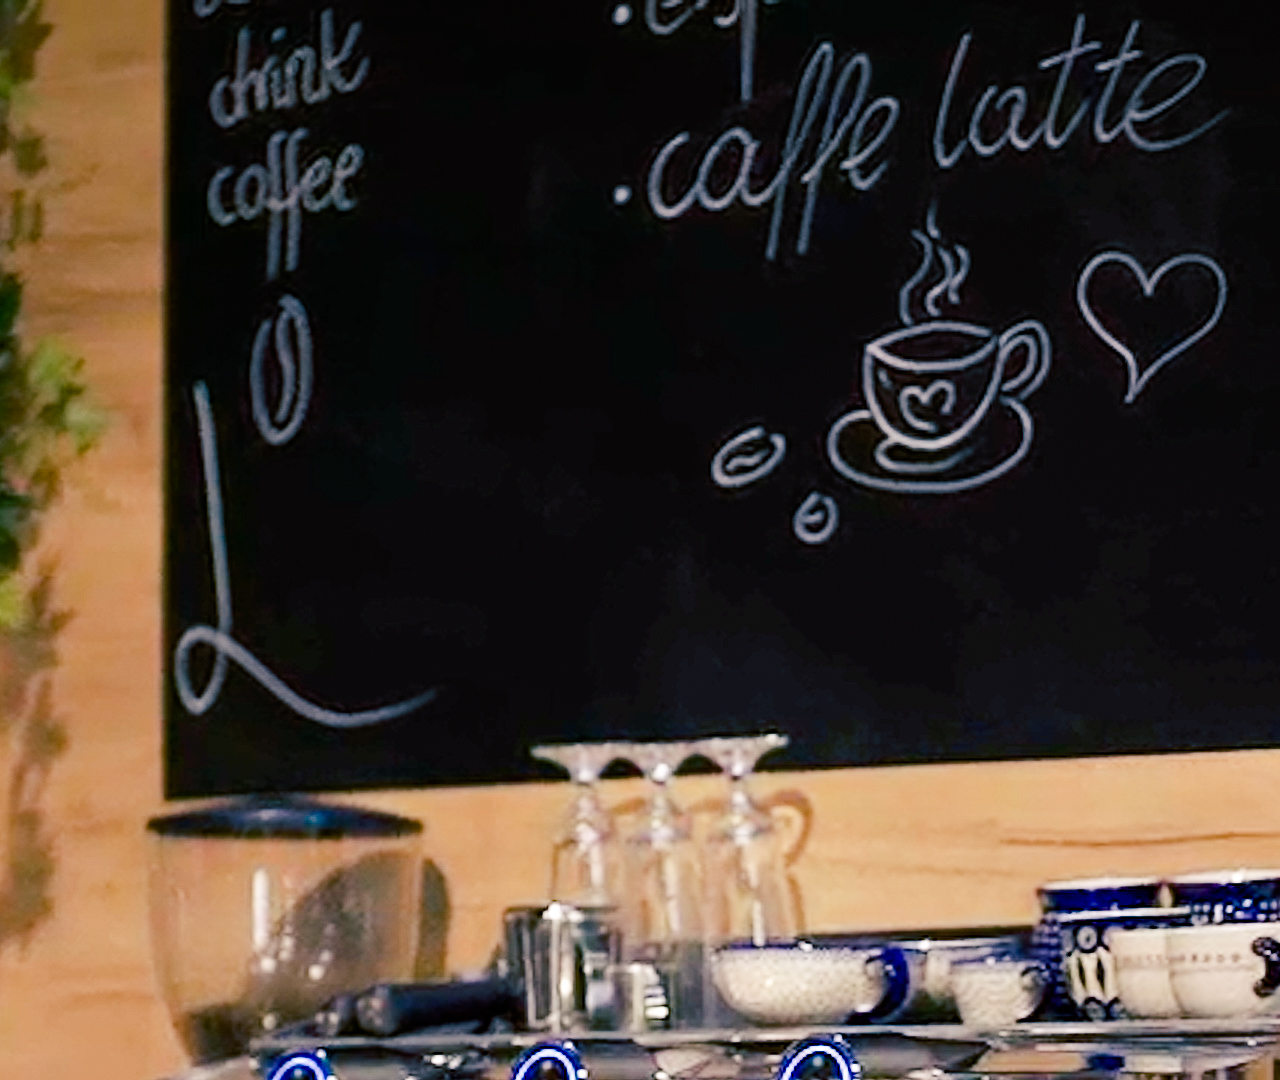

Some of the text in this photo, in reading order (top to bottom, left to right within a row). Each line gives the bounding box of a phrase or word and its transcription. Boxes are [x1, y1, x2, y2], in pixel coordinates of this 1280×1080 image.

[208, 8, 370, 128] drink
[647, 41, 900, 261] caffe
[932, 14, 1232, 169] latte
[207, 127, 366, 281] coffee
